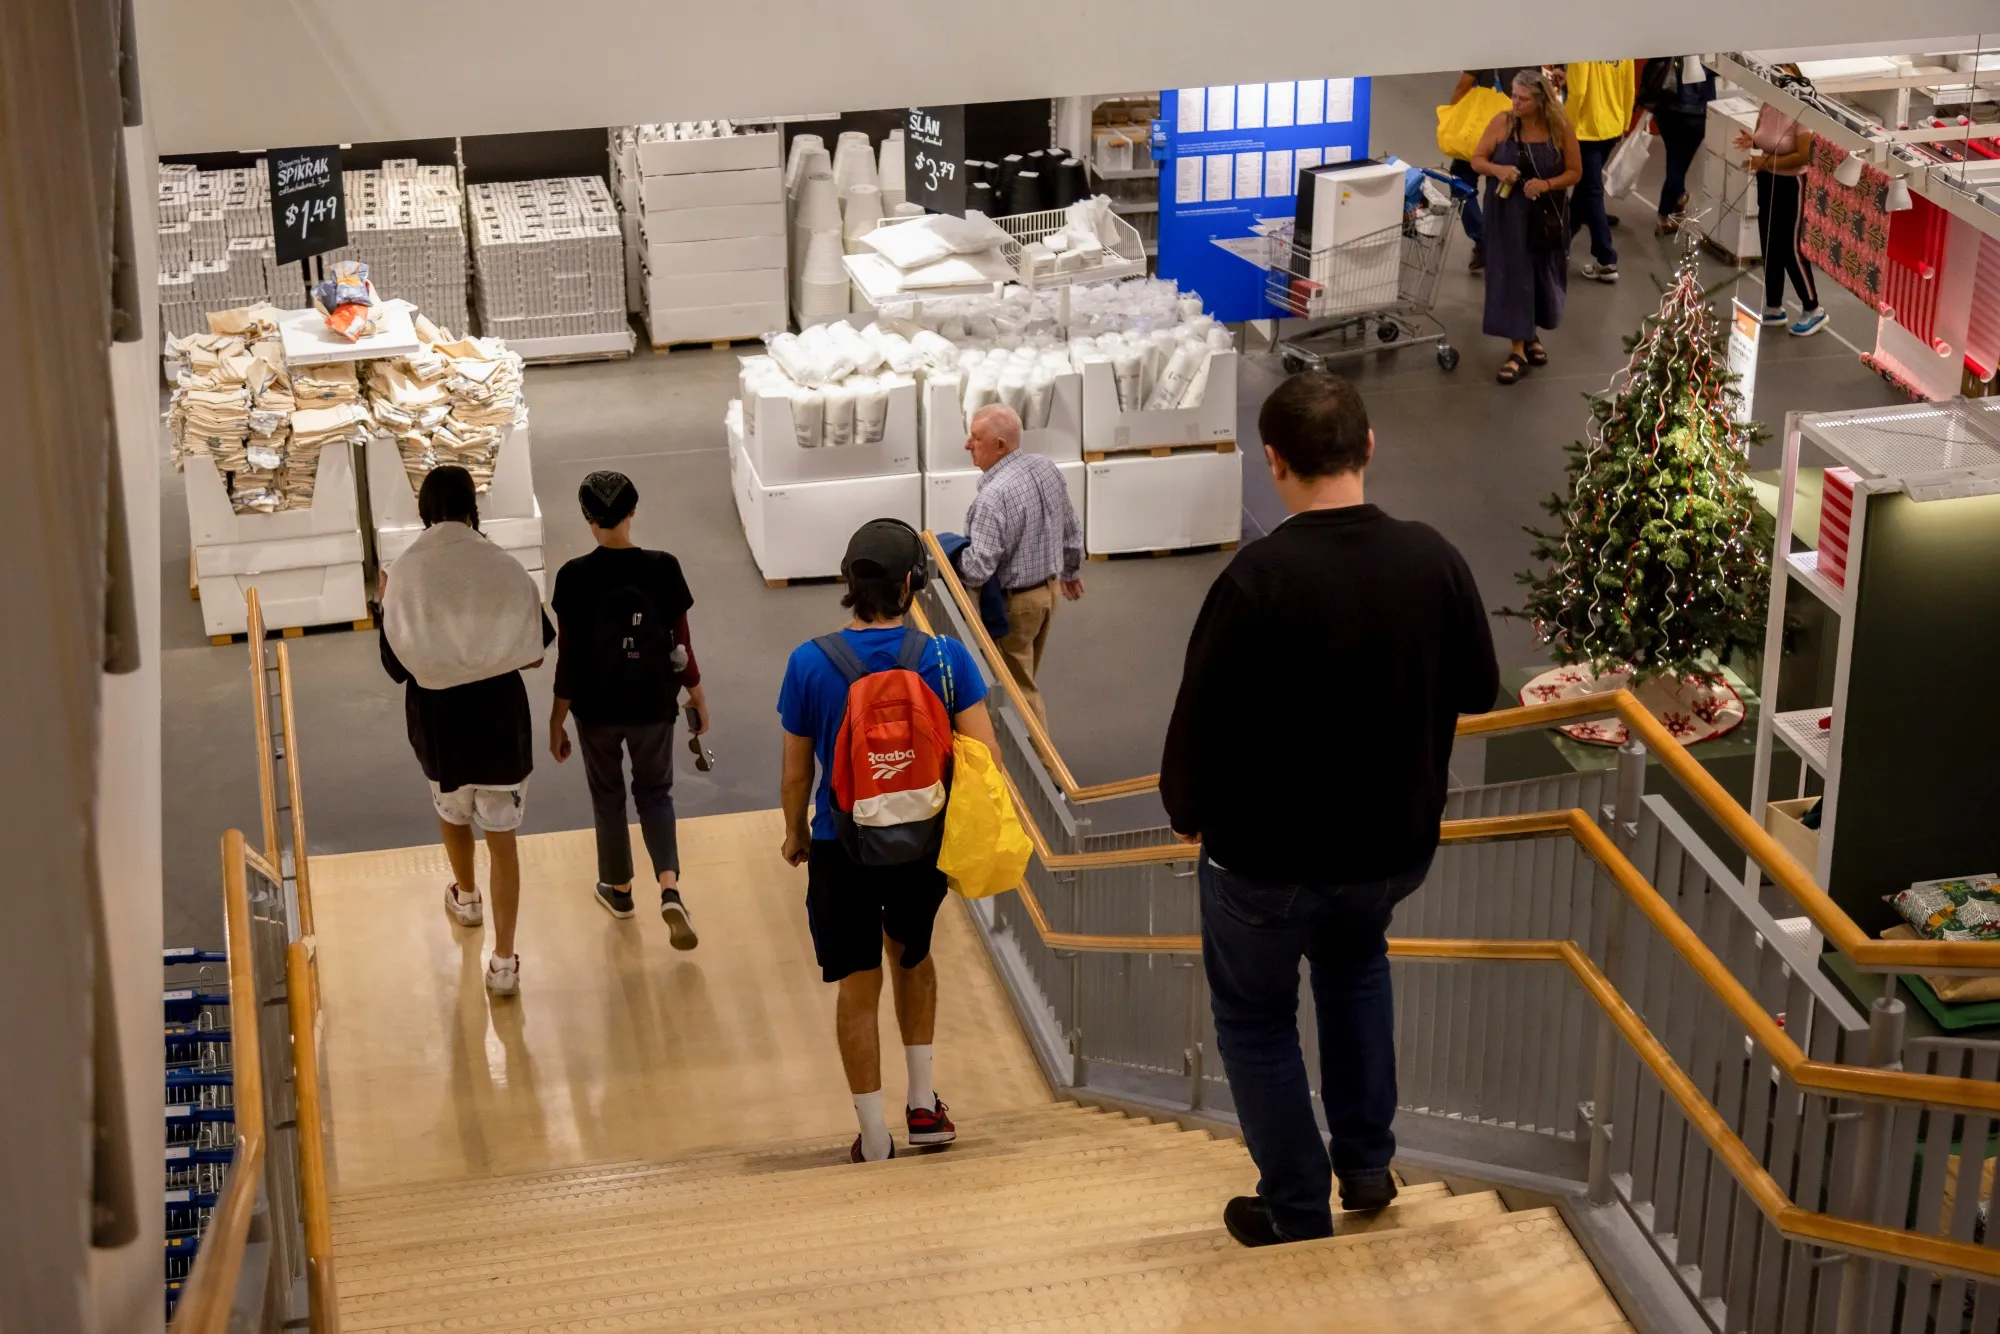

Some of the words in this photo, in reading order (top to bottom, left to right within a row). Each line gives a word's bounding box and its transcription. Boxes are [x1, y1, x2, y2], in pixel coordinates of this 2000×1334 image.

[278, 157, 329, 187] SPIKRAK
[914, 151, 956, 192] $3.79
[285, 196, 338, 240] $1.49
[867, 749, 916, 765] Reebo
